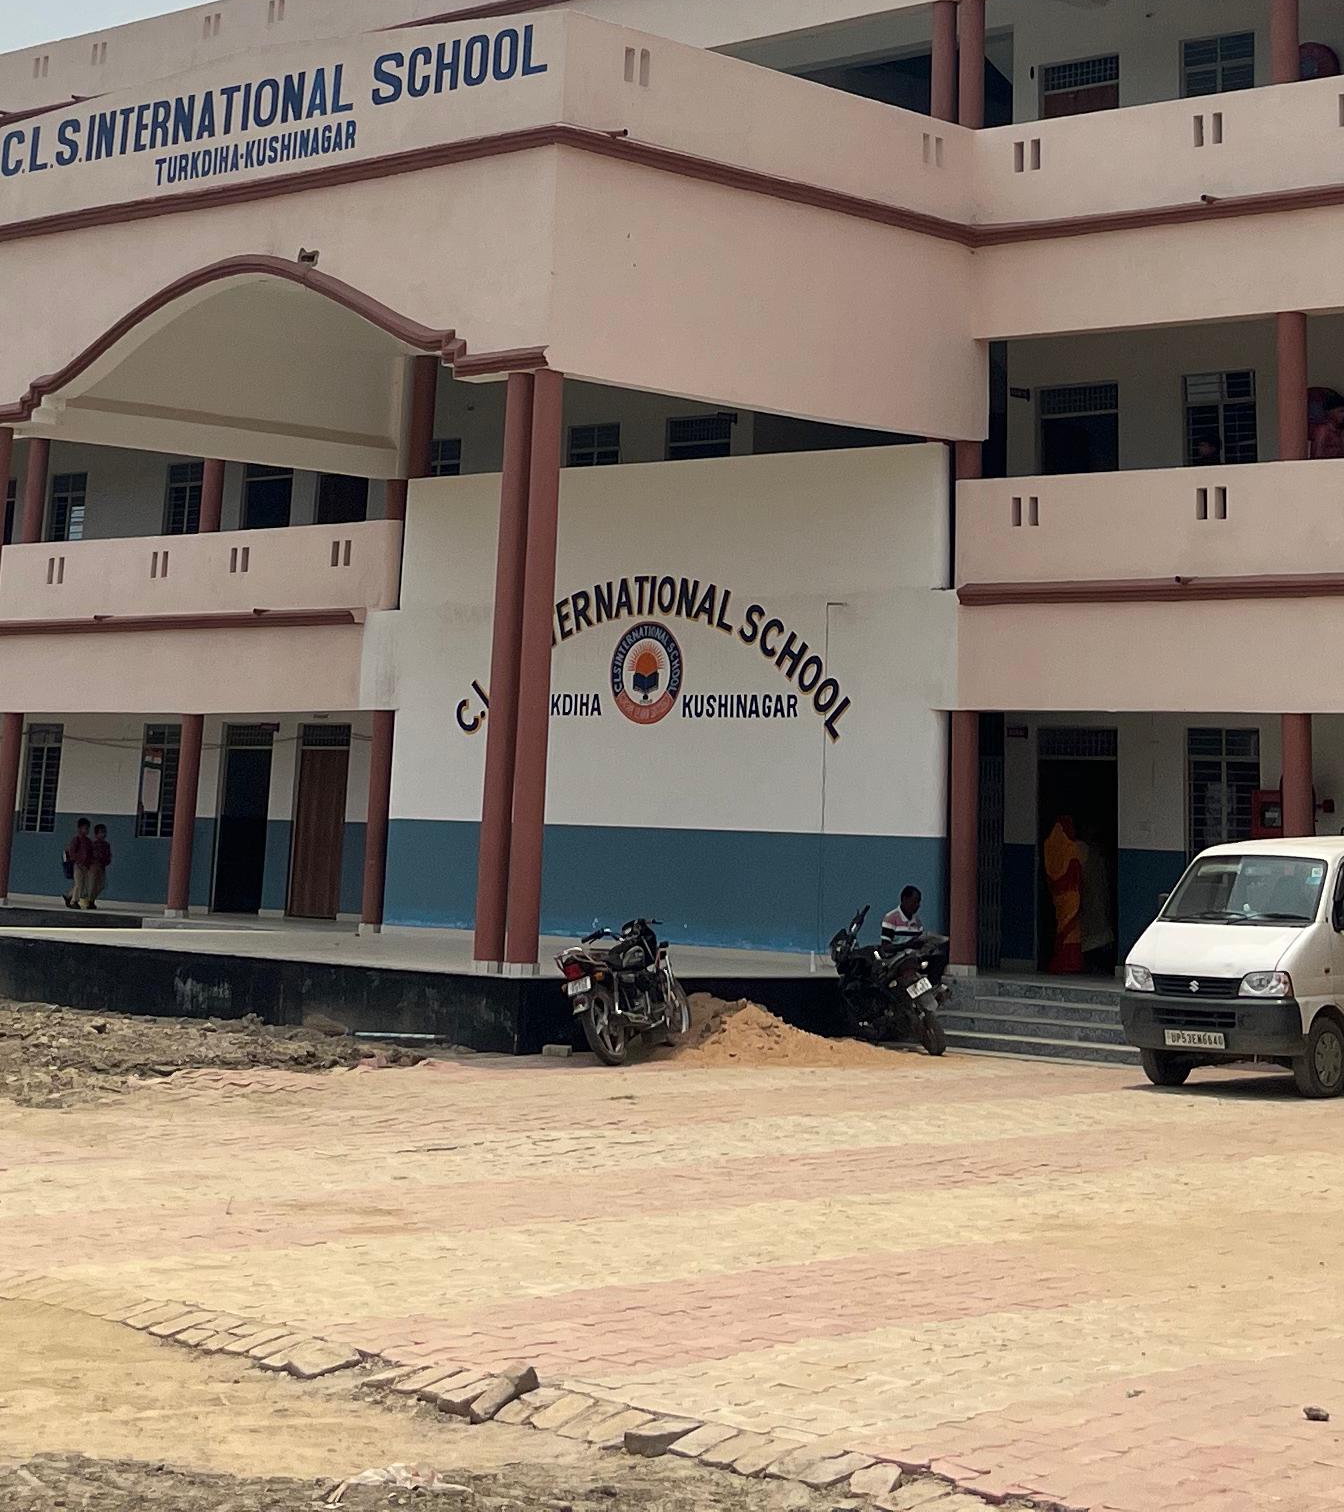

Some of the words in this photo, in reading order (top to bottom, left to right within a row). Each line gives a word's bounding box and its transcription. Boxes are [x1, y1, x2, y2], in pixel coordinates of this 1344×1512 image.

[371, 24, 548, 106] SCHOOL
[552, 575, 734, 647] ERNATIONAL
[738, 604, 851, 741] SCHOOL
[667, 642, 681, 691] SCHOOL
[682, 694, 798, 718] KUSHINAGAR
